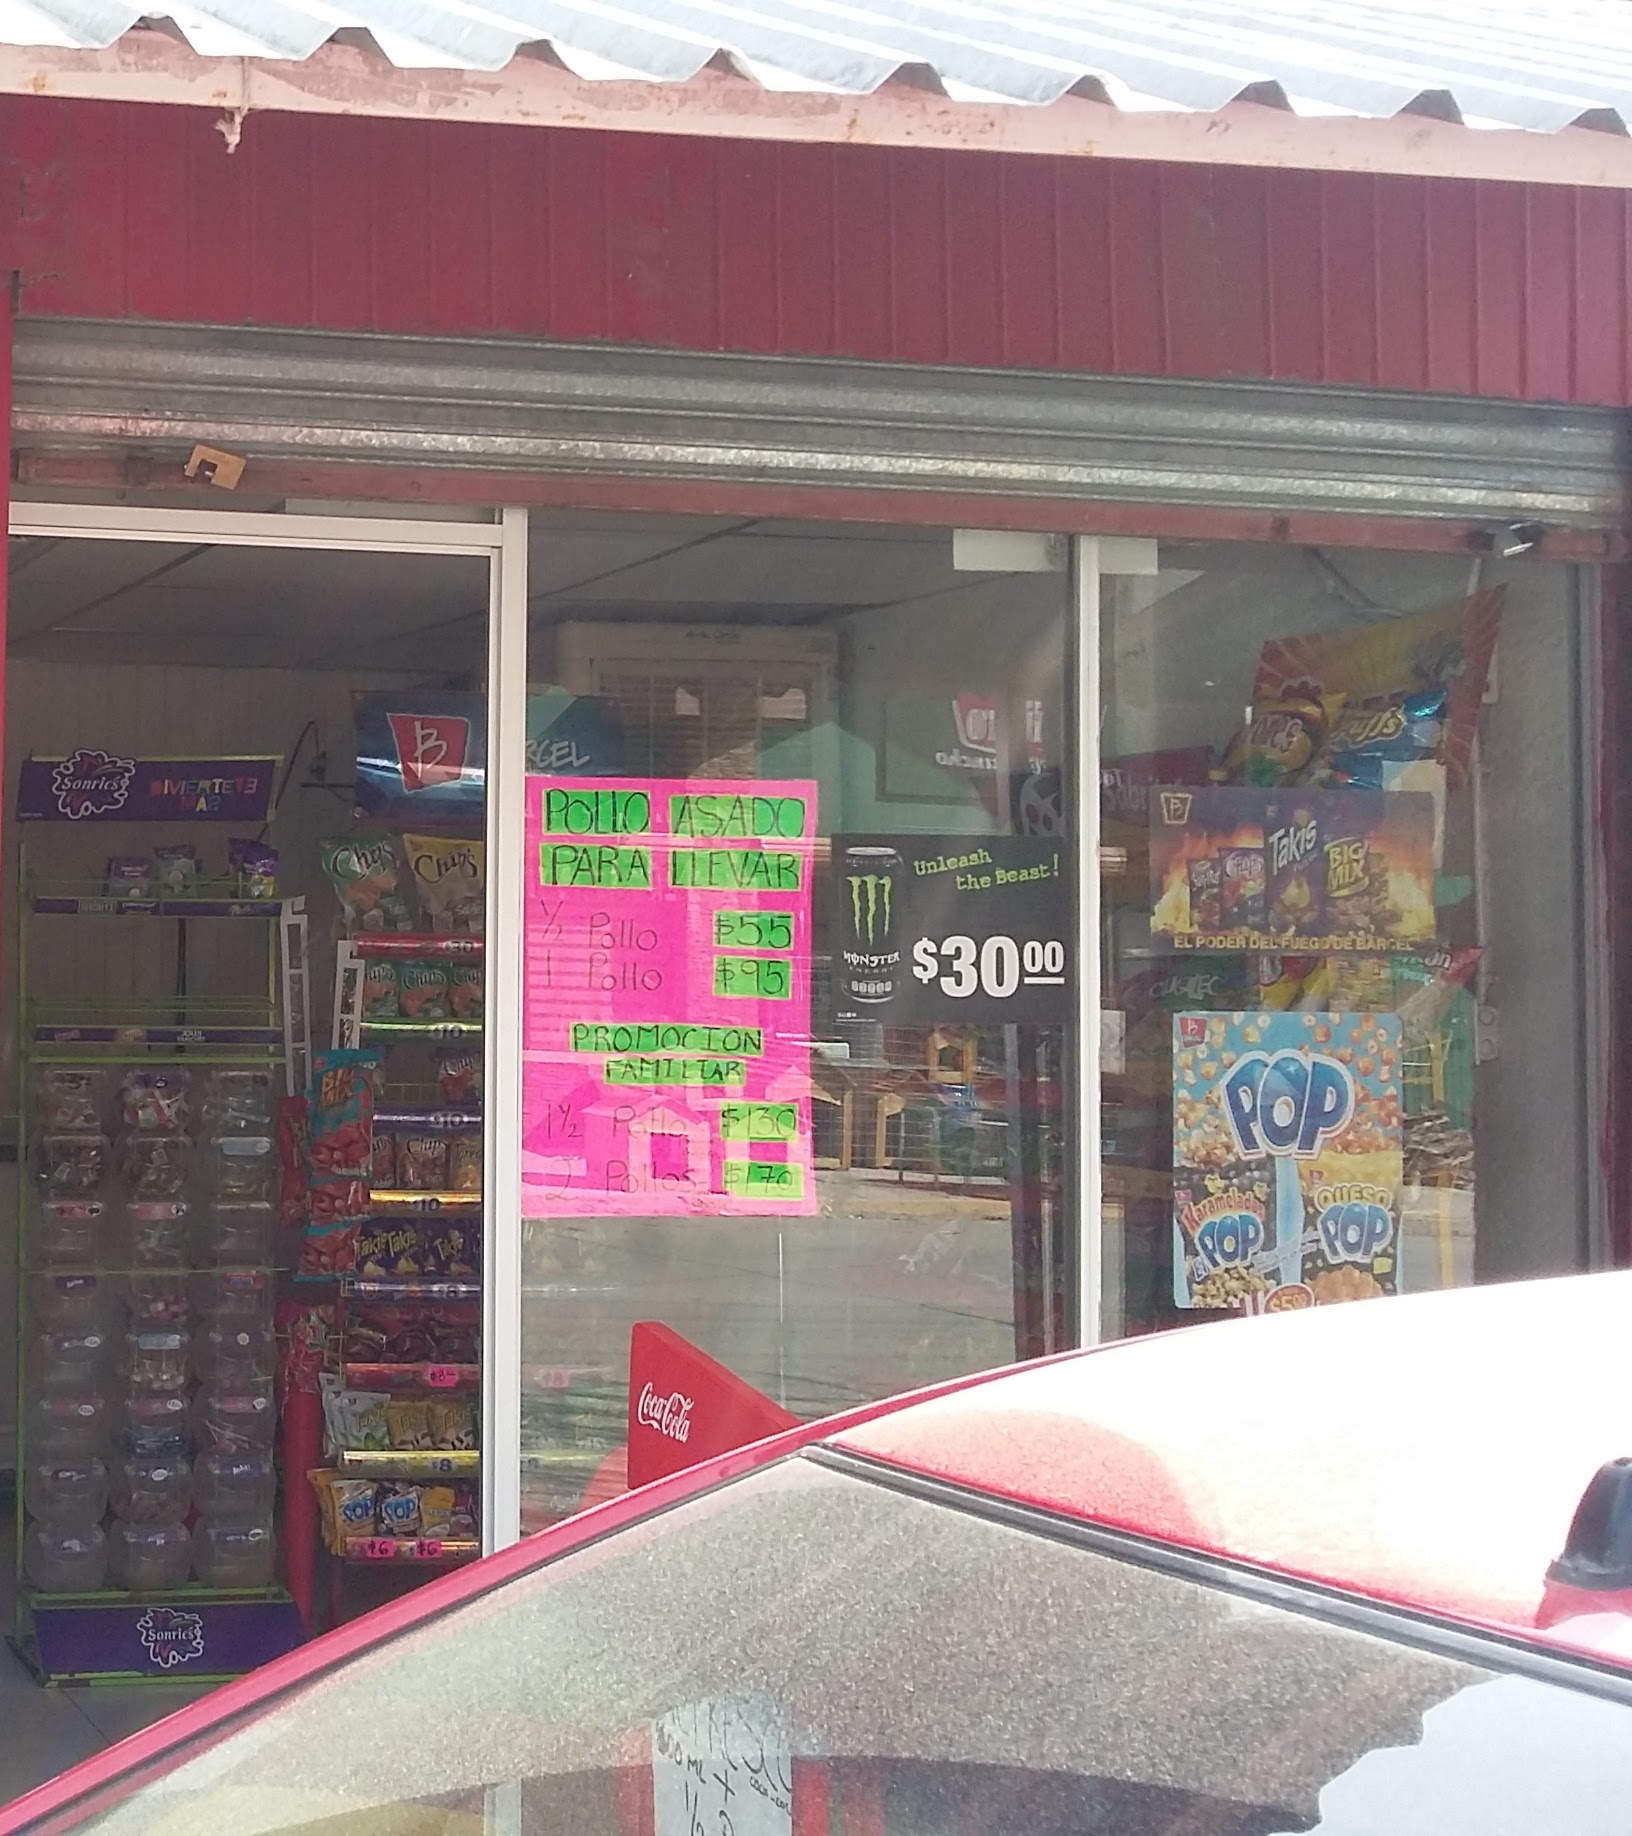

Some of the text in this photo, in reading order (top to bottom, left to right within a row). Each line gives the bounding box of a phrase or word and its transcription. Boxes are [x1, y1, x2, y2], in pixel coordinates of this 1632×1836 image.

[673, 796, 806, 838] ASADO
[551, 845, 800, 888] PARA LLEVAR
[914, 849, 992, 876] Unleash
[1269, 820, 1317, 876] Takis
[1330, 842, 1364, 868] BIG
[955, 853, 1059, 890] the Beast!
[589, 911, 658, 951] Pollo
[714, 914, 792, 948] $55
[1174, 936, 1193, 949] EL
[1196, 936, 1246, 949] PODER
[1252, 936, 1277, 949] DEL
[1281, 936, 1329, 950] FUEGO
[1332, 937, 1352, 950] DE
[589, 952, 662, 991] Pollo
[714, 958, 784, 994] $95
[843, 950, 901, 967] MONSTER
[574, 1023, 762, 1053] PROMOCION
[606, 1058, 743, 1083] FAMILIAR
[722, 1105, 797, 1136] $130
[1222, 1050, 1354, 1159] POP
[1316, 1183, 1391, 1212] QUESO
[1195, 1213, 1264, 1270] POP
[1318, 1202, 1392, 1263] POP
[638, 1381, 694, 1443] Coca-Cola
